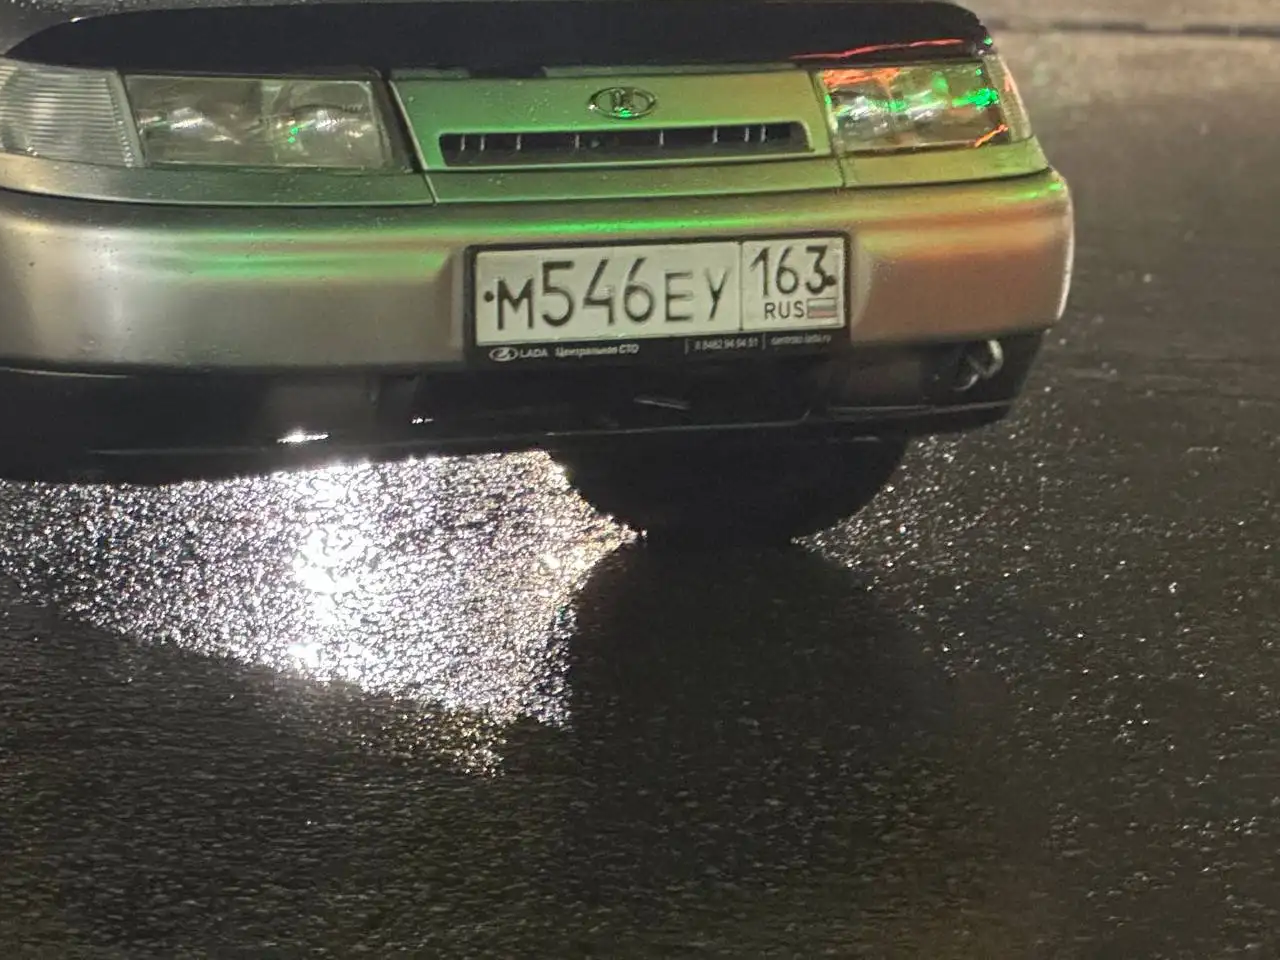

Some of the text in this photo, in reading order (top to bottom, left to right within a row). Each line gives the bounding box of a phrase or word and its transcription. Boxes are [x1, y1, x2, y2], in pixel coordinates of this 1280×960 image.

[749, 245, 828, 297] 163
[764, 300, 805, 320] RUS
[520, 348, 548, 359] LADA
